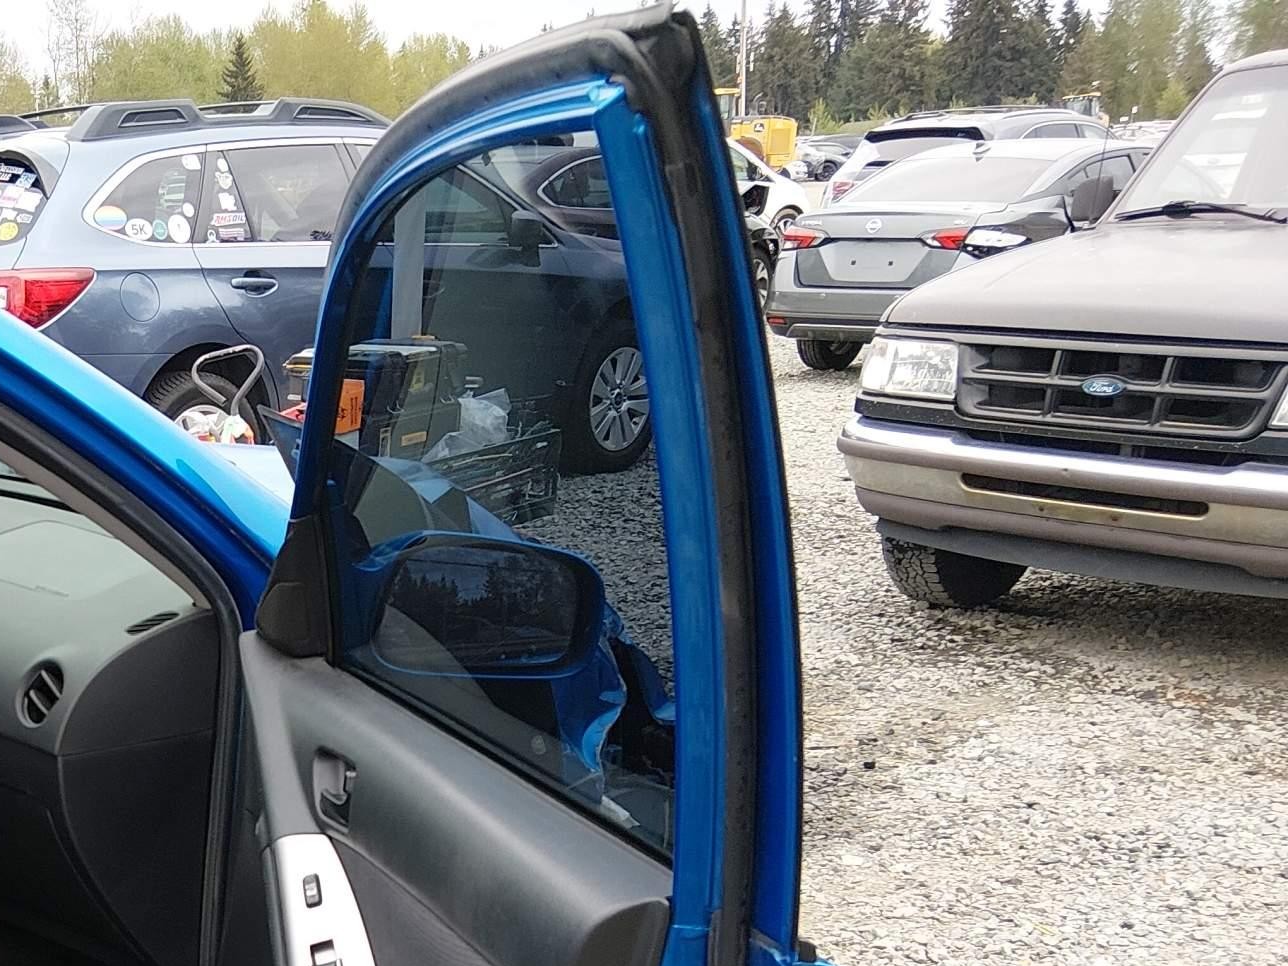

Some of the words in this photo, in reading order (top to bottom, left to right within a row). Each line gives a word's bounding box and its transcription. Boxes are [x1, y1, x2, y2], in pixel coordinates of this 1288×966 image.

[215, 214, 244, 225] AMSOIL
[131, 222, 148, 236] 5K
[1086, 380, 1120, 394] Ford
